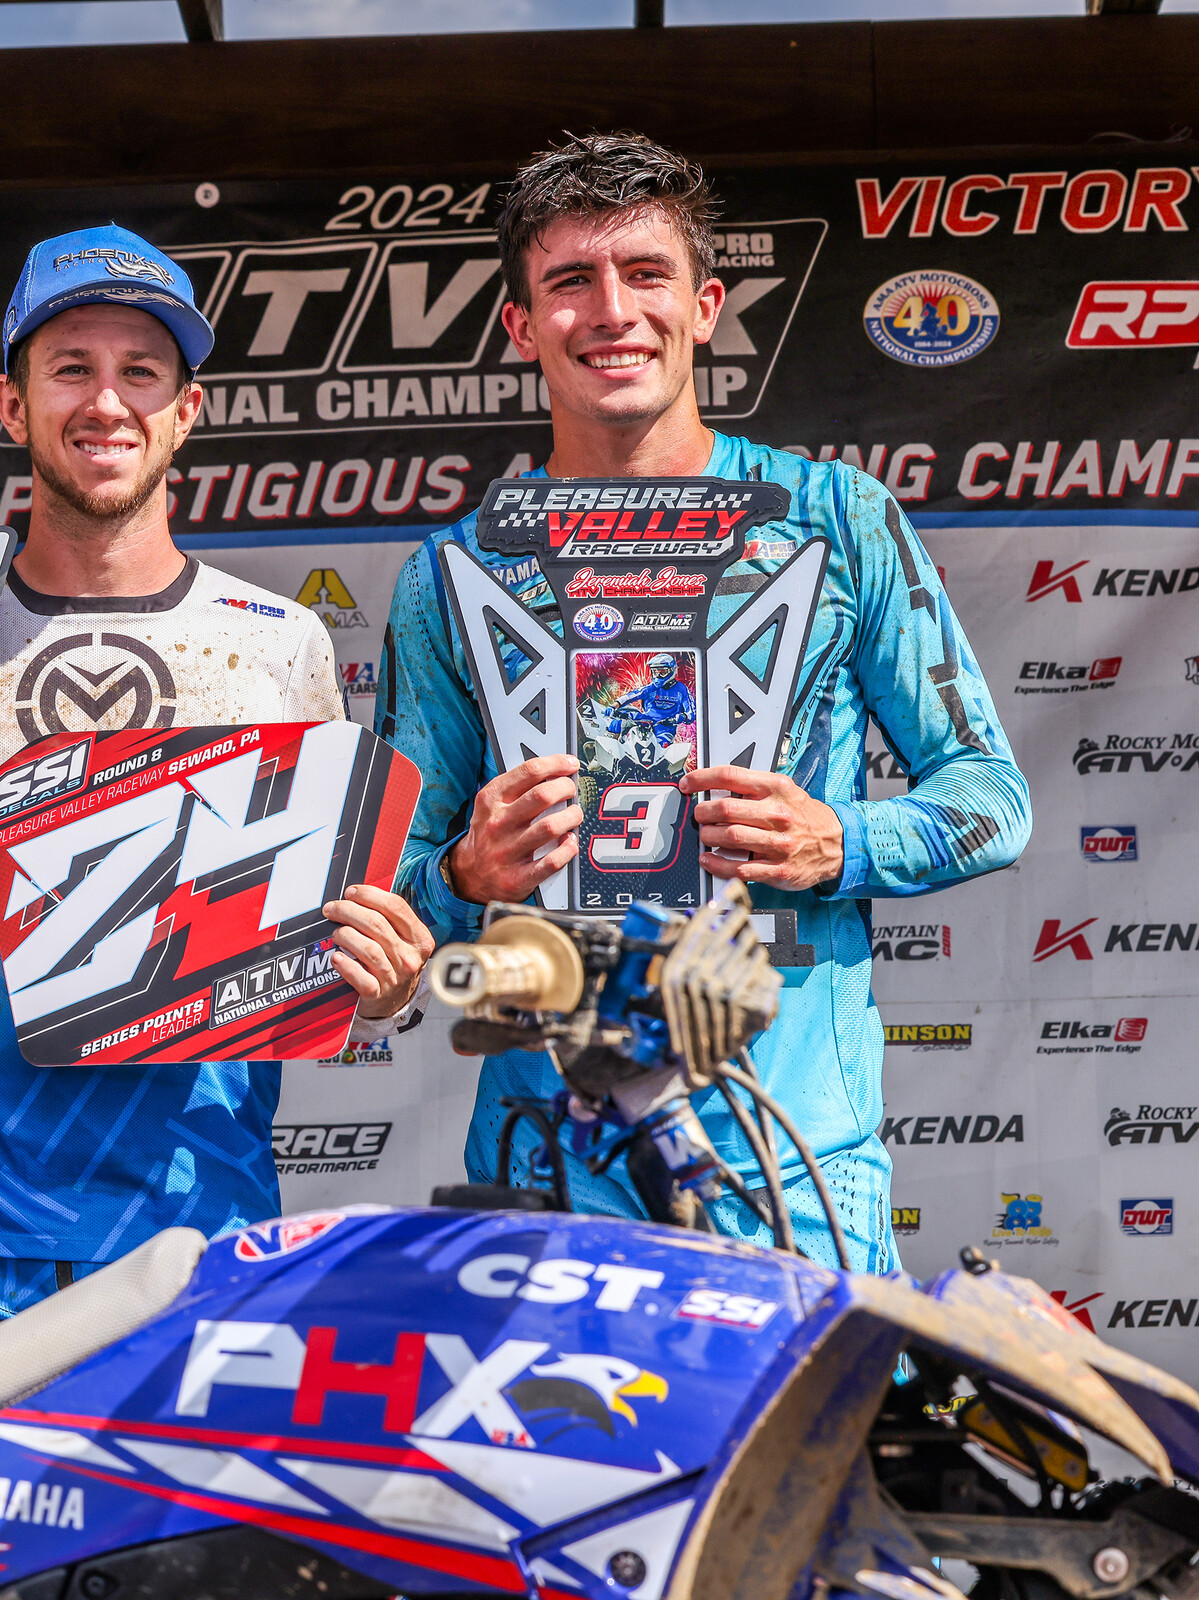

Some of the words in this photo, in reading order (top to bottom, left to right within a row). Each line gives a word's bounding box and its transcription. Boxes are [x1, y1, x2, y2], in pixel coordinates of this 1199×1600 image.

[326, 183, 491, 231] 2024
[857, 167, 1199, 238] VICTOR
[53, 248, 146, 268] PHOENIX
[873, 286, 895, 311] AMA
[894, 274, 917, 289] ATV
[919, 273, 990, 310] MOTOCROSS
[893, 295, 971, 336] 40
[870, 320, 916, 362] NATIONAL
[917, 318, 994, 365] CHAMPIONSHIP
[493, 486, 709, 511] PLEASURE
[548, 510, 748, 548] VALLEY
[567, 542, 724, 556] RACEWAY
[565, 567, 652, 592] Jeremiah
[651, 566, 707, 590] Jones
[604, 586, 703, 596] CHAMPIONSHIP
[211, 597, 258, 613] AMA
[258, 604, 286, 615] PRO
[258, 610, 286, 619] RACING
[584, 614, 614, 631] 40
[1019, 661, 1089, 680] Elka
[1014, 684, 1069, 695] Experience
[1070, 683, 1089, 693] The
[1090, 681, 1116, 691] Edge
[582, 704, 592, 716] 2
[1104, 734, 1167, 750] ROCKY
[641, 748, 652, 762] 2
[59, 790, 105, 820] VALLEY
[104, 767, 166, 804] RACEWAY
[167, 738, 238, 777] SEWARD,
[239, 729, 261, 752] PA
[92, 751, 149, 786] ROUND
[150, 748, 163, 764] 8
[591, 784, 686, 866] 3
[1083, 835, 1135, 852] DWT
[585, 892, 696, 907] 2024
[872, 924, 939, 940] UNTAIN
[215, 947, 337, 1008] ATVM
[215, 996, 271, 1025] NATIONAL
[271, 969, 341, 1002] CHAMPIONS
[80, 1022, 141, 1058] SERIES
[142, 999, 205, 1038] POINTS
[152, 1012, 203, 1044] LEADER
[1041, 1021, 1114, 1039] Elka
[357, 1051, 392, 1063] YEARS
[1036, 1045, 1093, 1054] Experience
[1095, 1045, 1112, 1053] The
[1114, 1045, 1141, 1054] Edge
[1135, 1105, 1196, 1121] ROCKY
[881, 1114, 1024, 1144] KENDA
[272, 1126, 387, 1156] RACE
[1122, 1208, 1172, 1226] DWT
[458, 1253, 664, 1312] CST
[678, 1290, 780, 1328] SSI
[175, 1319, 551, 1448] PHX
